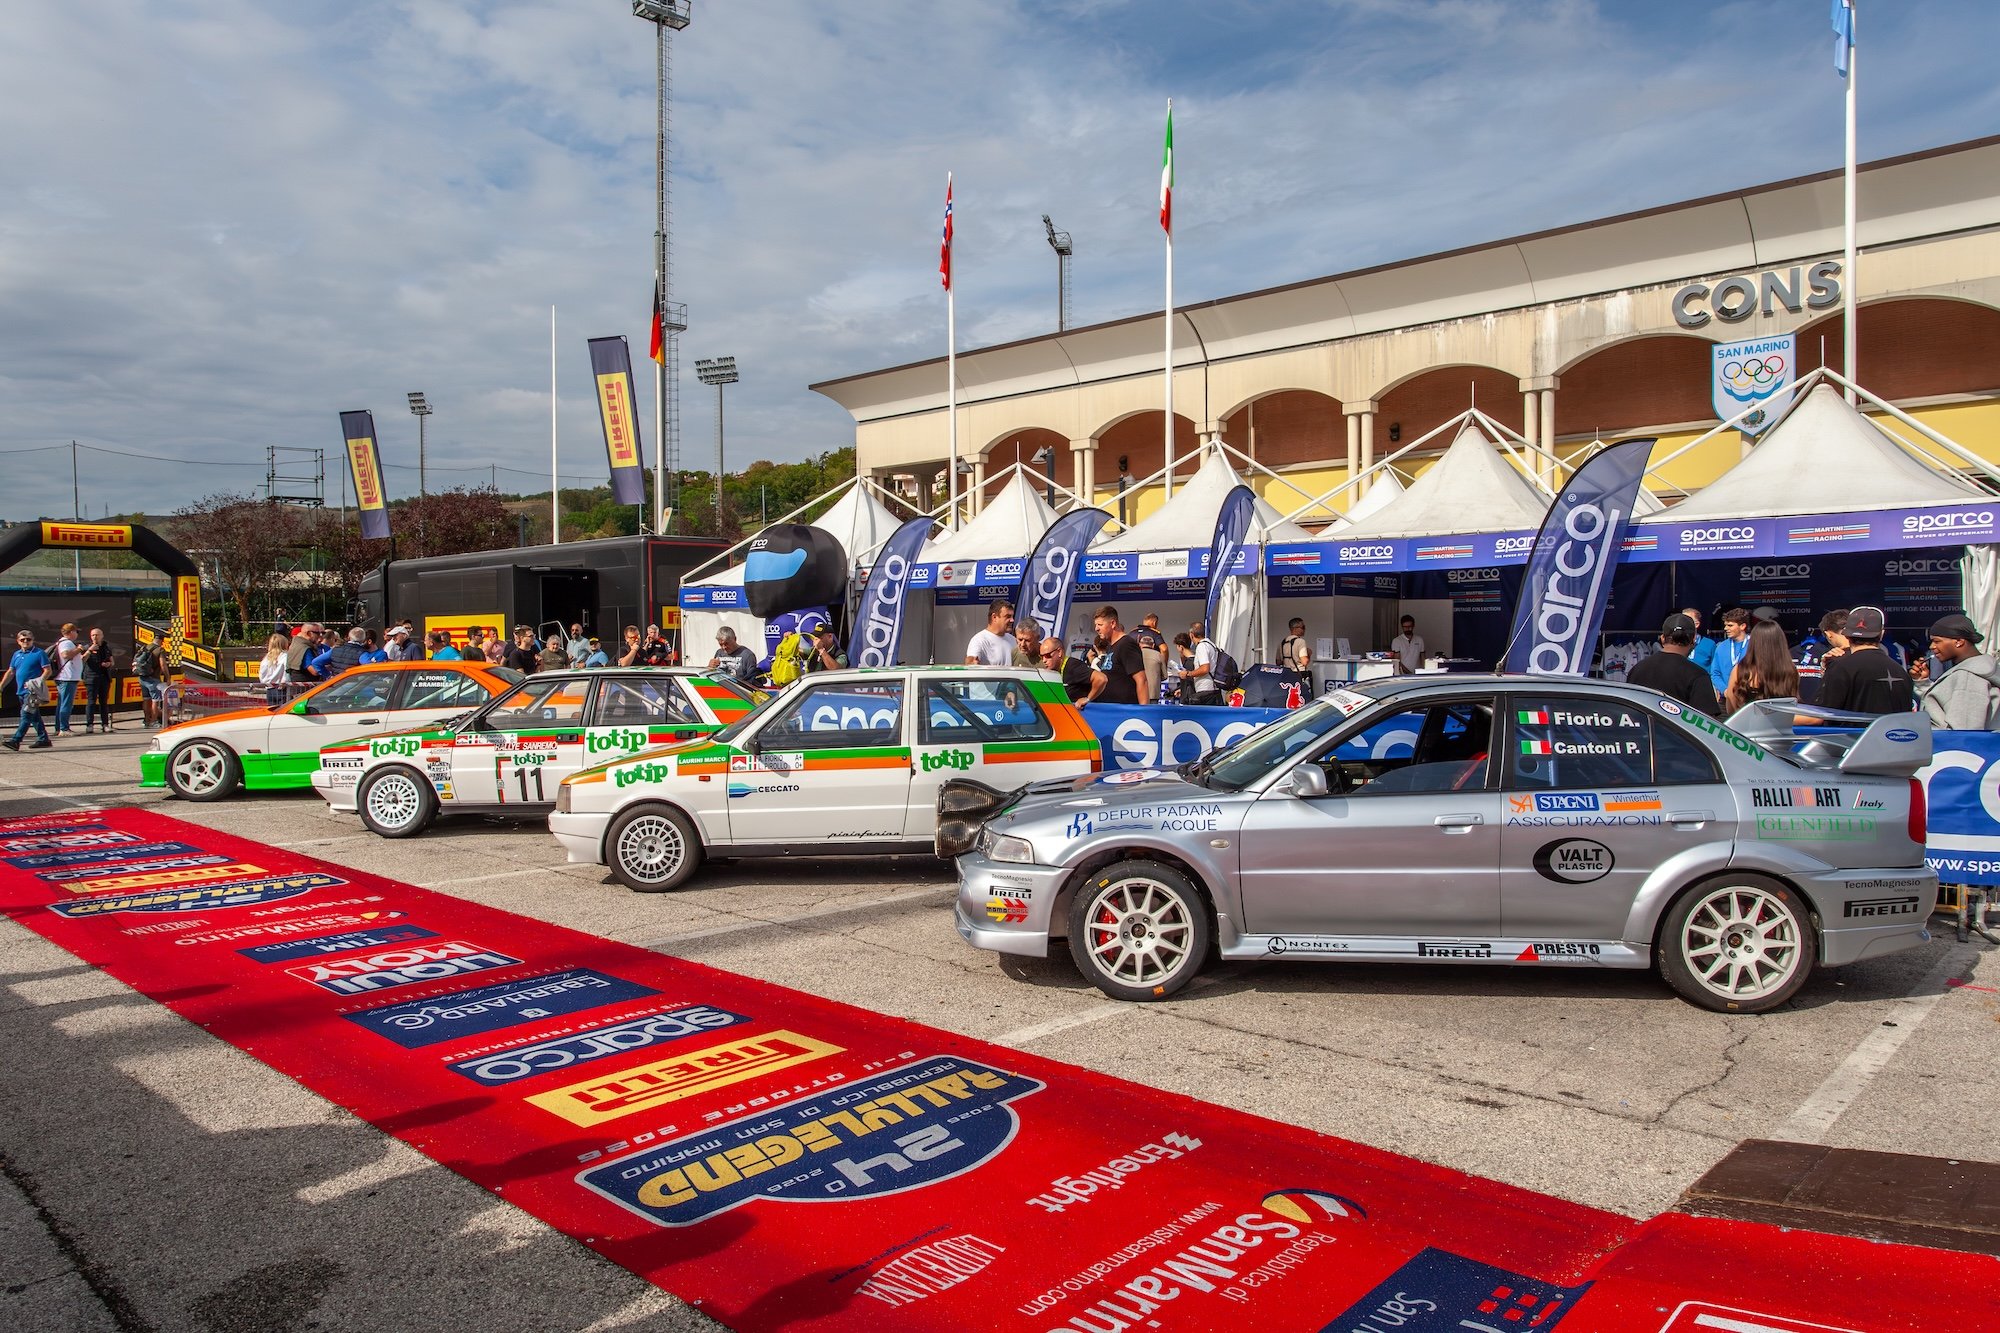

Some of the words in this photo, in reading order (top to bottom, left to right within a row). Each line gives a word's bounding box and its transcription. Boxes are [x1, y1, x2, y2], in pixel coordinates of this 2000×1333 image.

[1672, 261, 1843, 327] CONS
[1717, 347, 1741, 359] SAN
[1743, 340, 1790, 355] MARINO
[604, 381, 633, 459] PIRELLI
[354, 444, 379, 505] PIRELLI
[1902, 511, 1994, 532] sparco
[51, 527, 124, 543] PIRELLI
[1680, 526, 1755, 545] sparco
[1340, 545, 1393, 561] sparco
[985, 563, 1021, 576] sparco
[1086, 558, 1127, 573] sparco
[1740, 563, 1811, 581] sparco
[1282, 575, 1325, 587] sparco
[1448, 568, 1500, 583] sparco
[979, 586, 1009, 597] sparco
[1167, 579, 1206, 592] sparco
[1526, 503, 1605, 675] parco
[712, 590, 737, 602] sparco
[183, 582, 199, 639] PIRELLI
[1554, 711, 1613, 727] Fiorio
[1619, 713, 1641, 728] A.
[586, 729, 647, 753] totip
[1680, 710, 1765, 762] ULTRON
[370, 736, 421, 758] totip
[495, 742, 520, 751] RALLYE
[522, 741, 558, 750] SANREMO
[1554, 740, 1621, 755] Cantoni
[1625, 742, 1641, 754] P.
[323, 758, 363, 767] PIRELLI
[512, 753, 546, 766] totip
[920, 748, 975, 772] totip
[614, 762, 668, 787] totip
[513, 767, 545, 802] 11
[758, 785, 800, 793] CECCATO
[1540, 795, 1596, 810] STAGNI
[1612, 793, 1661, 803] Winterthur
[1860, 800, 1884, 809] Italy
[1098, 807, 1152, 821] DEPUR
[1157, 804, 1222, 817] PADANA
[1507, 815, 1661, 827] ASSICURAZIONI
[1161, 819, 1217, 831] ACQUE
[1761, 817, 1873, 832] GLENFIELD
[1558, 848, 1603, 861] VALT
[46, 856, 229, 880] sparco
[1558, 862, 1603, 870] PLASTIC
[989, 885, 1032, 899] PIRELLI
[1844, 878, 1921, 890] TecnoMagnesio
[250, 897, 365, 916] Enerlight
[1844, 896, 1920, 918] PIRELLI
[121, 919, 210, 937] LAURETANA
[174, 915, 361, 946] SanMarino
[333, 932, 368, 940] San
[254, 934, 328, 953] Marino
[318, 936, 388, 952] TIM
[1417, 942, 1492, 958] PIRELLI
[1533, 943, 1601, 954] PRESTO
[305, 942, 479, 982] MOLY
[327, 953, 511, 993] LIQUI
[441, 975, 612, 1020] EBERHARD
[663, 1001, 692, 1011] THE
[577, 1020, 595, 1029] OF
[603, 1008, 659, 1023] POWER
[441, 1027, 573, 1062] PERFORMANCE
[475, 1013, 735, 1080] sparco
[568, 1038, 812, 1112] PIRELLI
[831, 1062, 957, 1106] REPUBBLICA
[702, 1072, 846, 1122] OTTOBRE
[797, 1107, 821, 1118] DI
[734, 1118, 786, 1139] SAN
[636, 1069, 1009, 1208] RALLYLEGEND
[621, 1139, 723, 1180] MARINO
[1025, 1142, 1176, 1215] Enerlight
[1018, 1201, 1225, 1317] www.visitsanmarino.com
[1238, 1231, 1337, 1289] Repubblica
[853, 1233, 1007, 1309] LAURETANA
[1219, 1285, 1250, 1304] di
[1369, 1291, 1438, 1327] San
